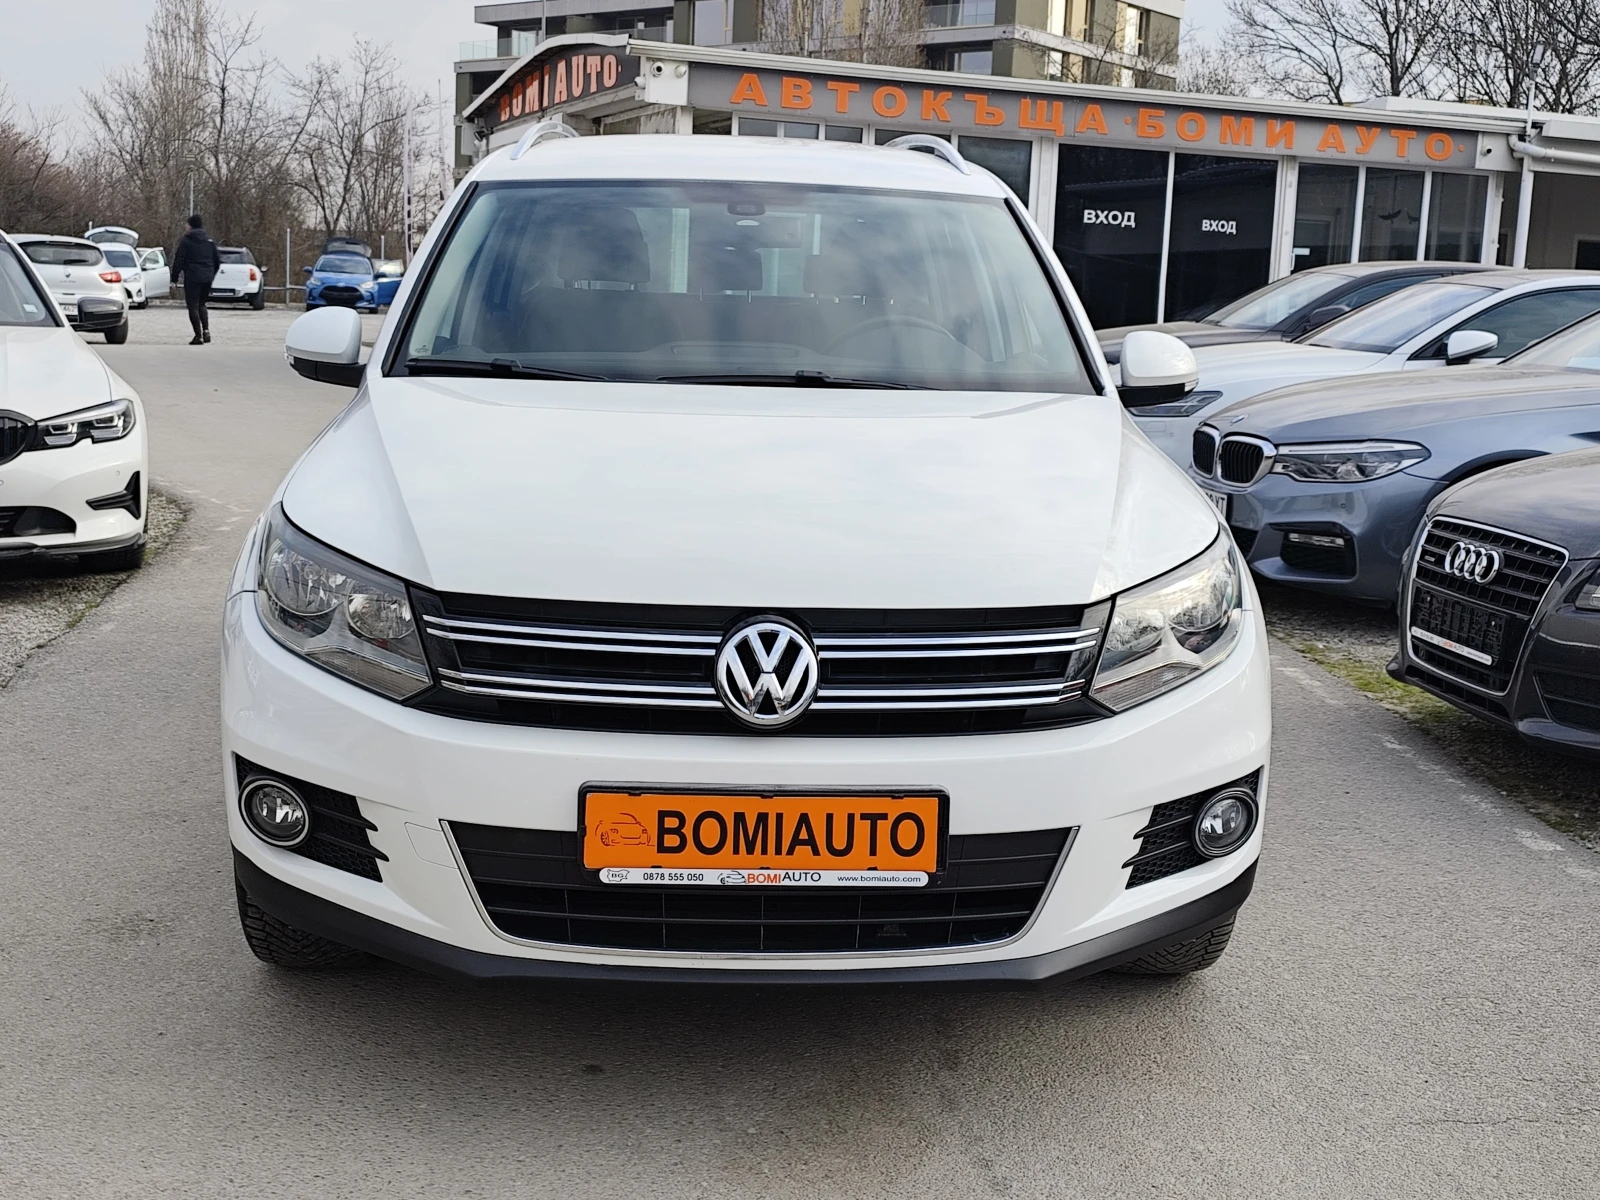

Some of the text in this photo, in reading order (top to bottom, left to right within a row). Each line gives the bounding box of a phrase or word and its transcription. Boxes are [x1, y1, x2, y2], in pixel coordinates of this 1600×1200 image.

[729, 72, 1109, 137] АВТОКЪЩА
[1082, 209, 1136, 228] ВХОД
[1201, 219, 1237, 235] ВХОД
[656, 809, 926, 858] BOMIAUTO
[643, 872, 666, 881] 0878
[668, 872, 685, 881] 555
[686, 873, 704, 882] 050
[837, 875, 921, 883] www.bomiauto.com
